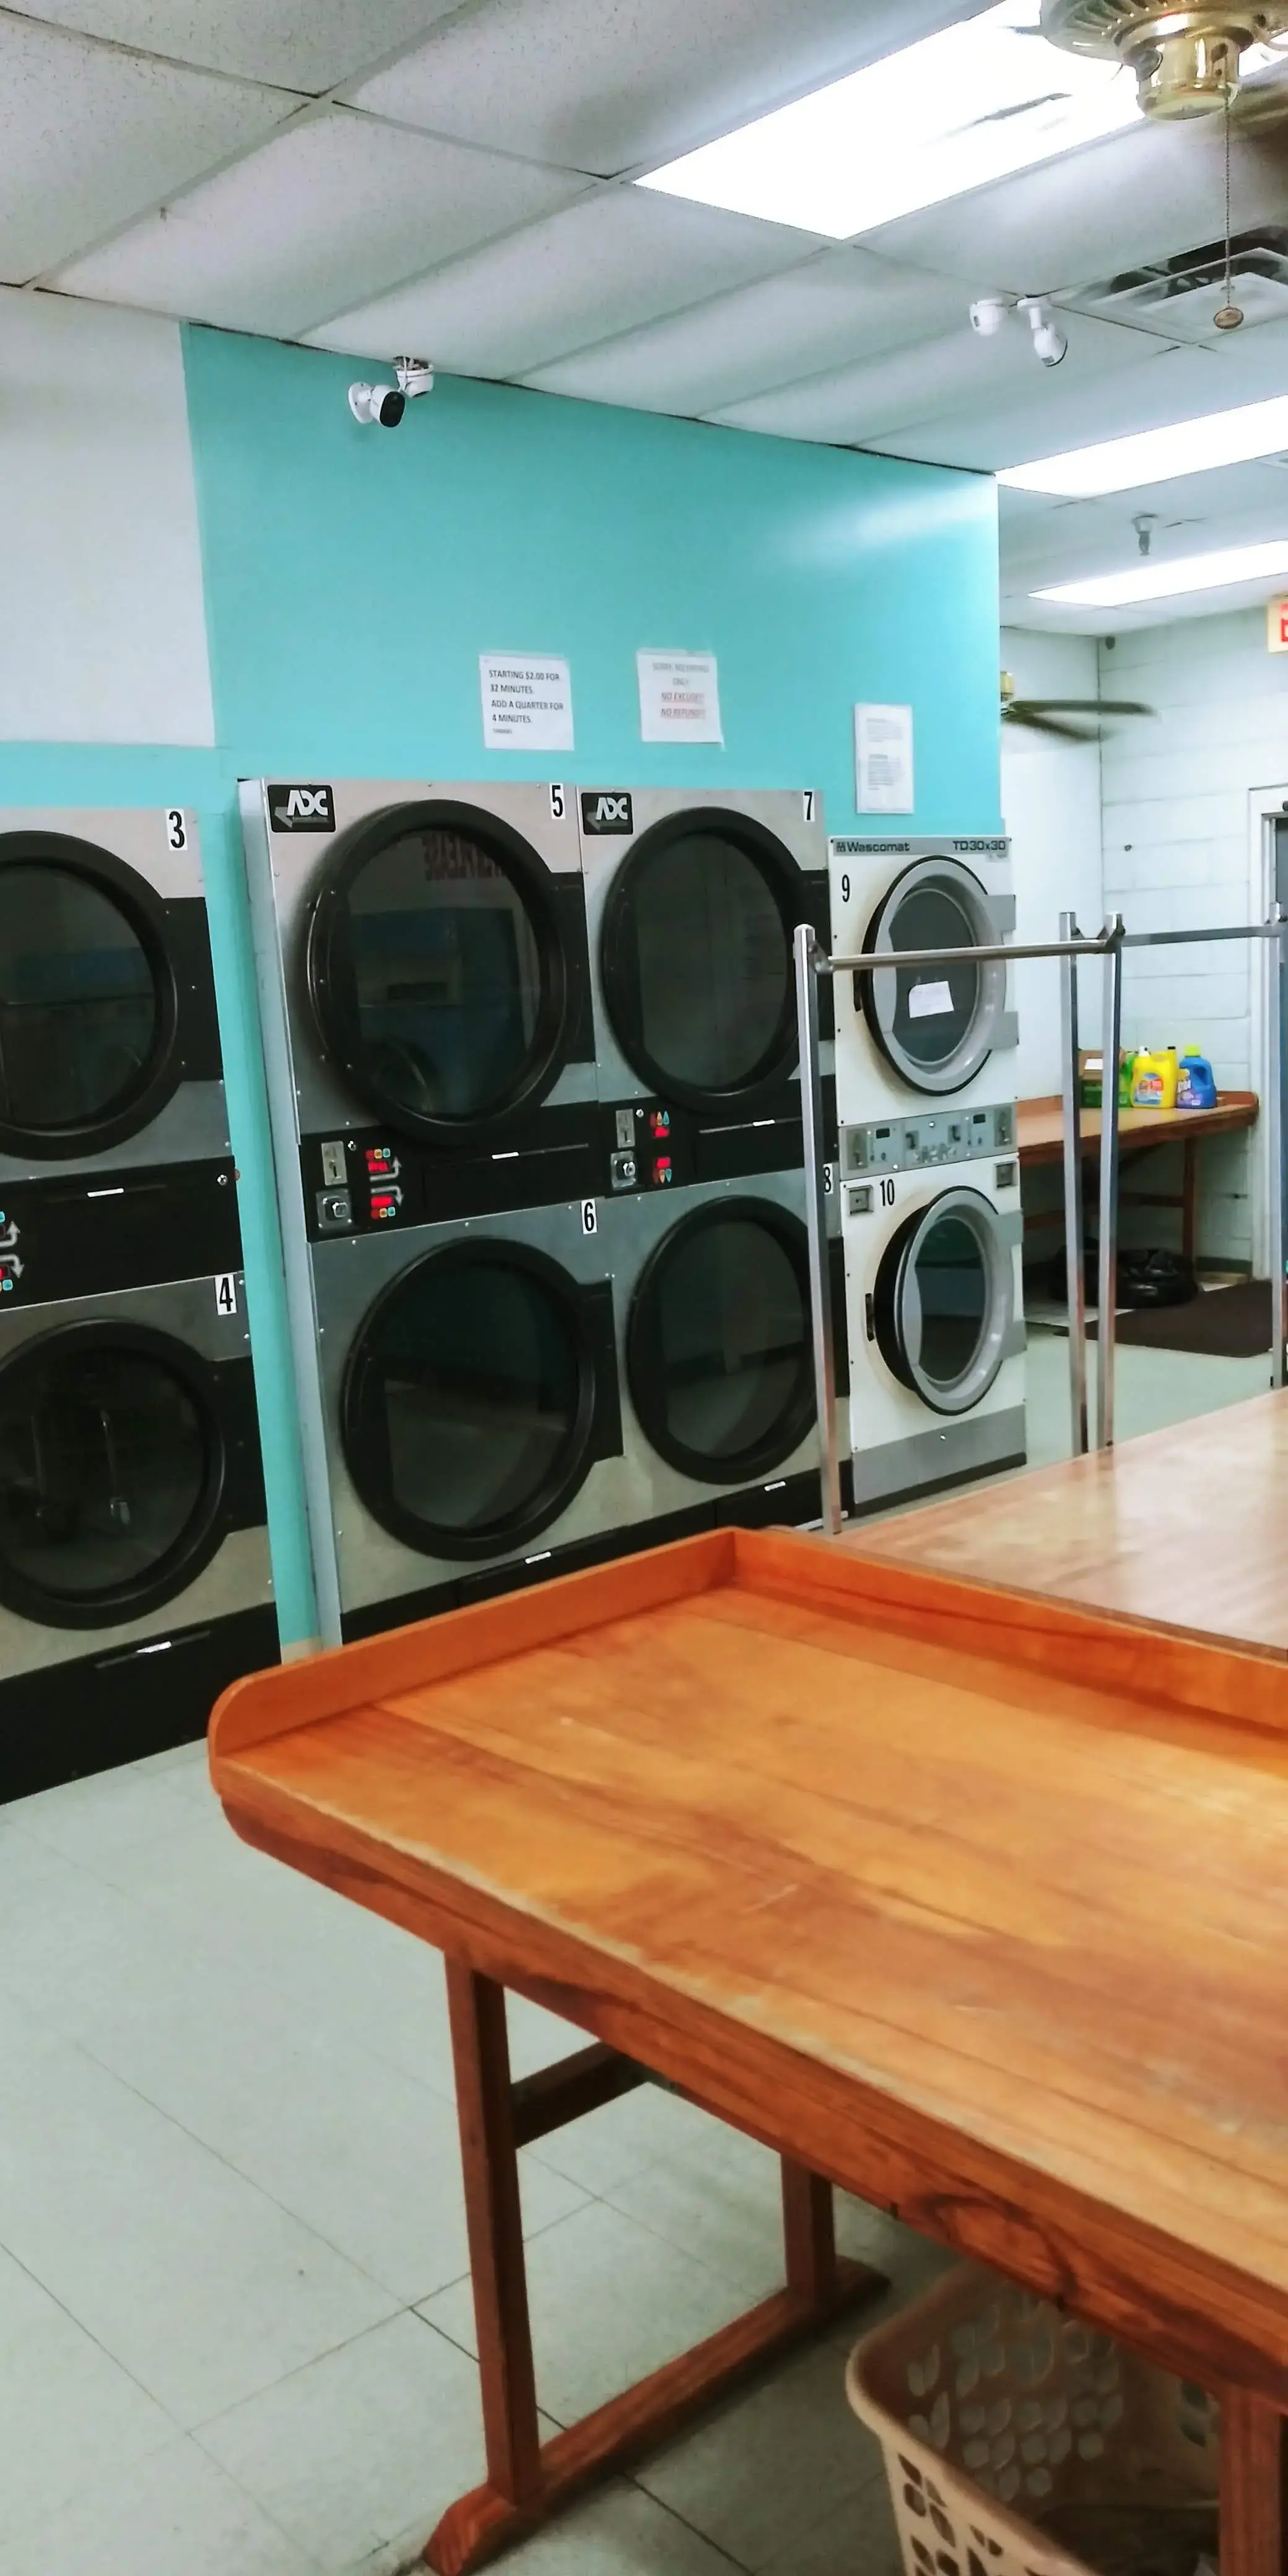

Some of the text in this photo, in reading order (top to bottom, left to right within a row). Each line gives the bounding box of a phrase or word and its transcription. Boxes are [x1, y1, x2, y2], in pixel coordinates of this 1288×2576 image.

[489, 670, 560, 681] STARTING $2.00 FOR
[490, 684, 498, 692] 32
[491, 700, 507, 708] ADD
[515, 701, 548, 710] QUARTER
[549, 702, 564, 710] FOR
[287, 790, 328, 816] ADC
[552, 785, 563, 817] 5
[596, 797, 629, 820] ADC
[804, 791, 812, 820] 7
[169, 811, 185, 848] 3
[846, 842, 910, 851] Wascomat
[842, 874, 850, 902] 9
[824, 1167, 832, 1193] 8
[879, 1179, 895, 1206] 10
[584, 1202, 594, 1232] 6
[220, 1277, 233, 1312] 4
